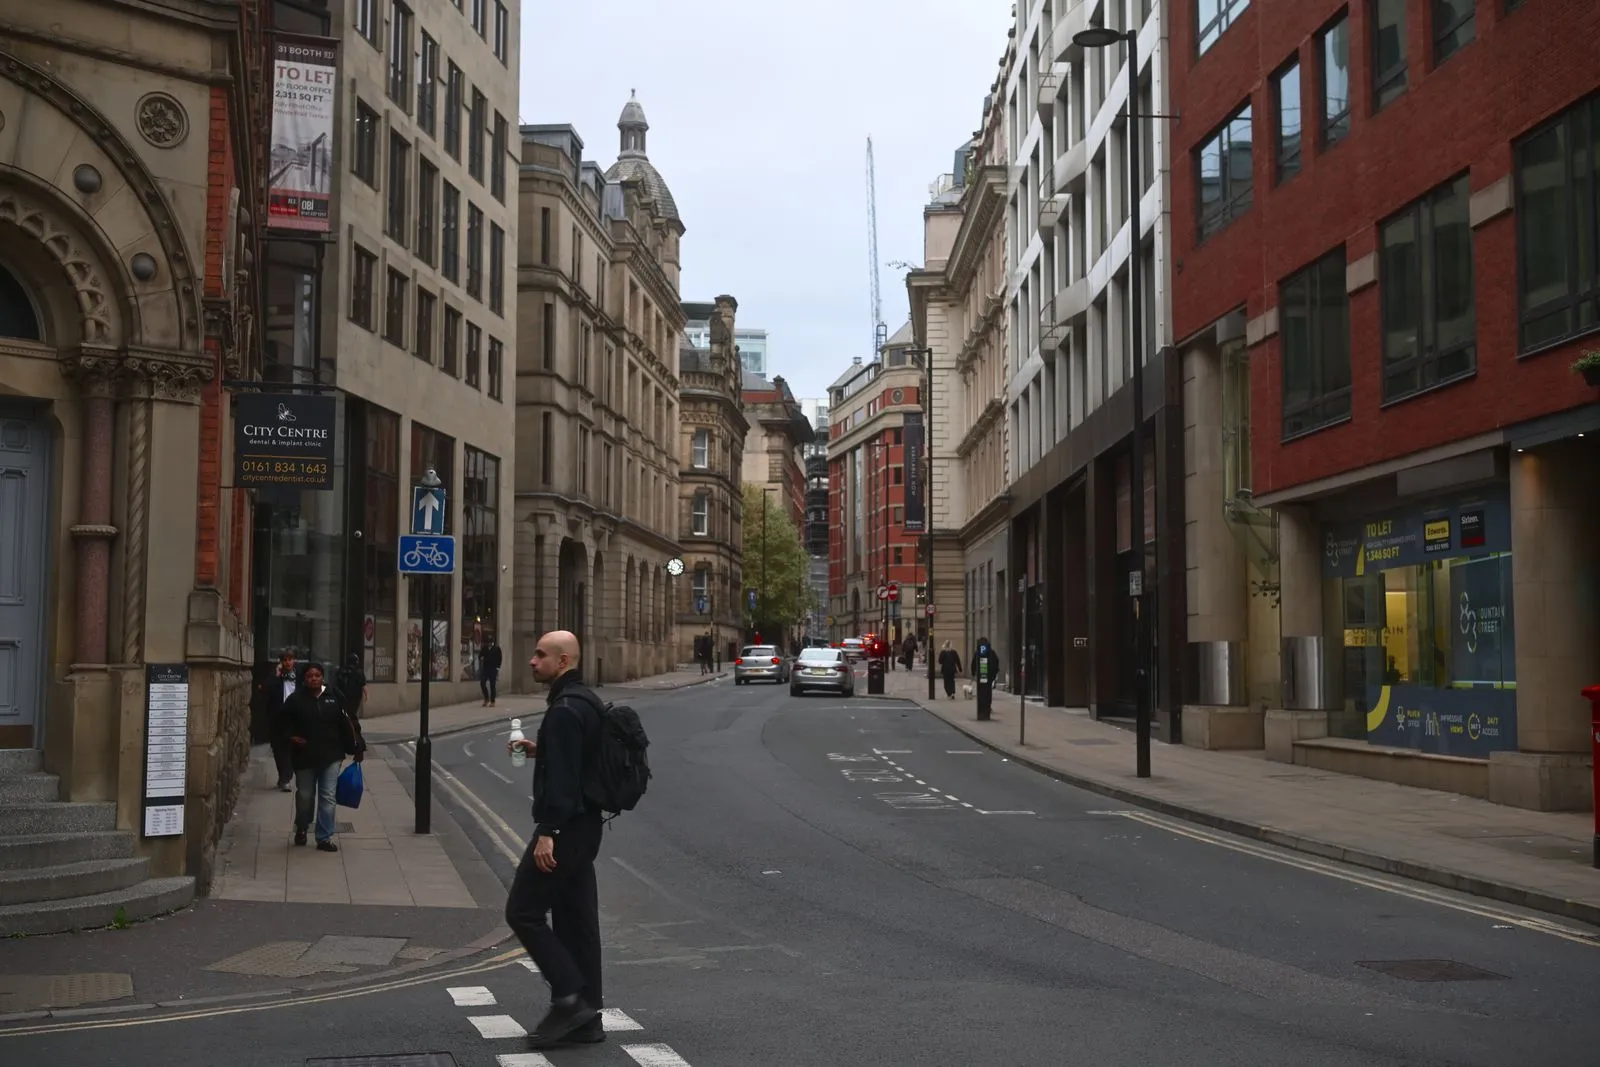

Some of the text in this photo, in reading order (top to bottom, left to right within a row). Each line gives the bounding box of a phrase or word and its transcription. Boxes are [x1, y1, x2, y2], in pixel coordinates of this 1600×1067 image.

[278, 45, 287, 53] 31
[289, 47, 322, 57] BOOTH
[276, 65, 334, 84] TO LET
[275, 90, 298, 100] 2,311
[299, 93, 312, 102] SQ
[242, 461, 327, 474] 0161 834 1643
[1366, 520, 1392, 537] TO LET
[1382, 547, 1391, 559] SQ
[1391, 546, 1400, 557] FT
[980, 645, 986, 653] P
